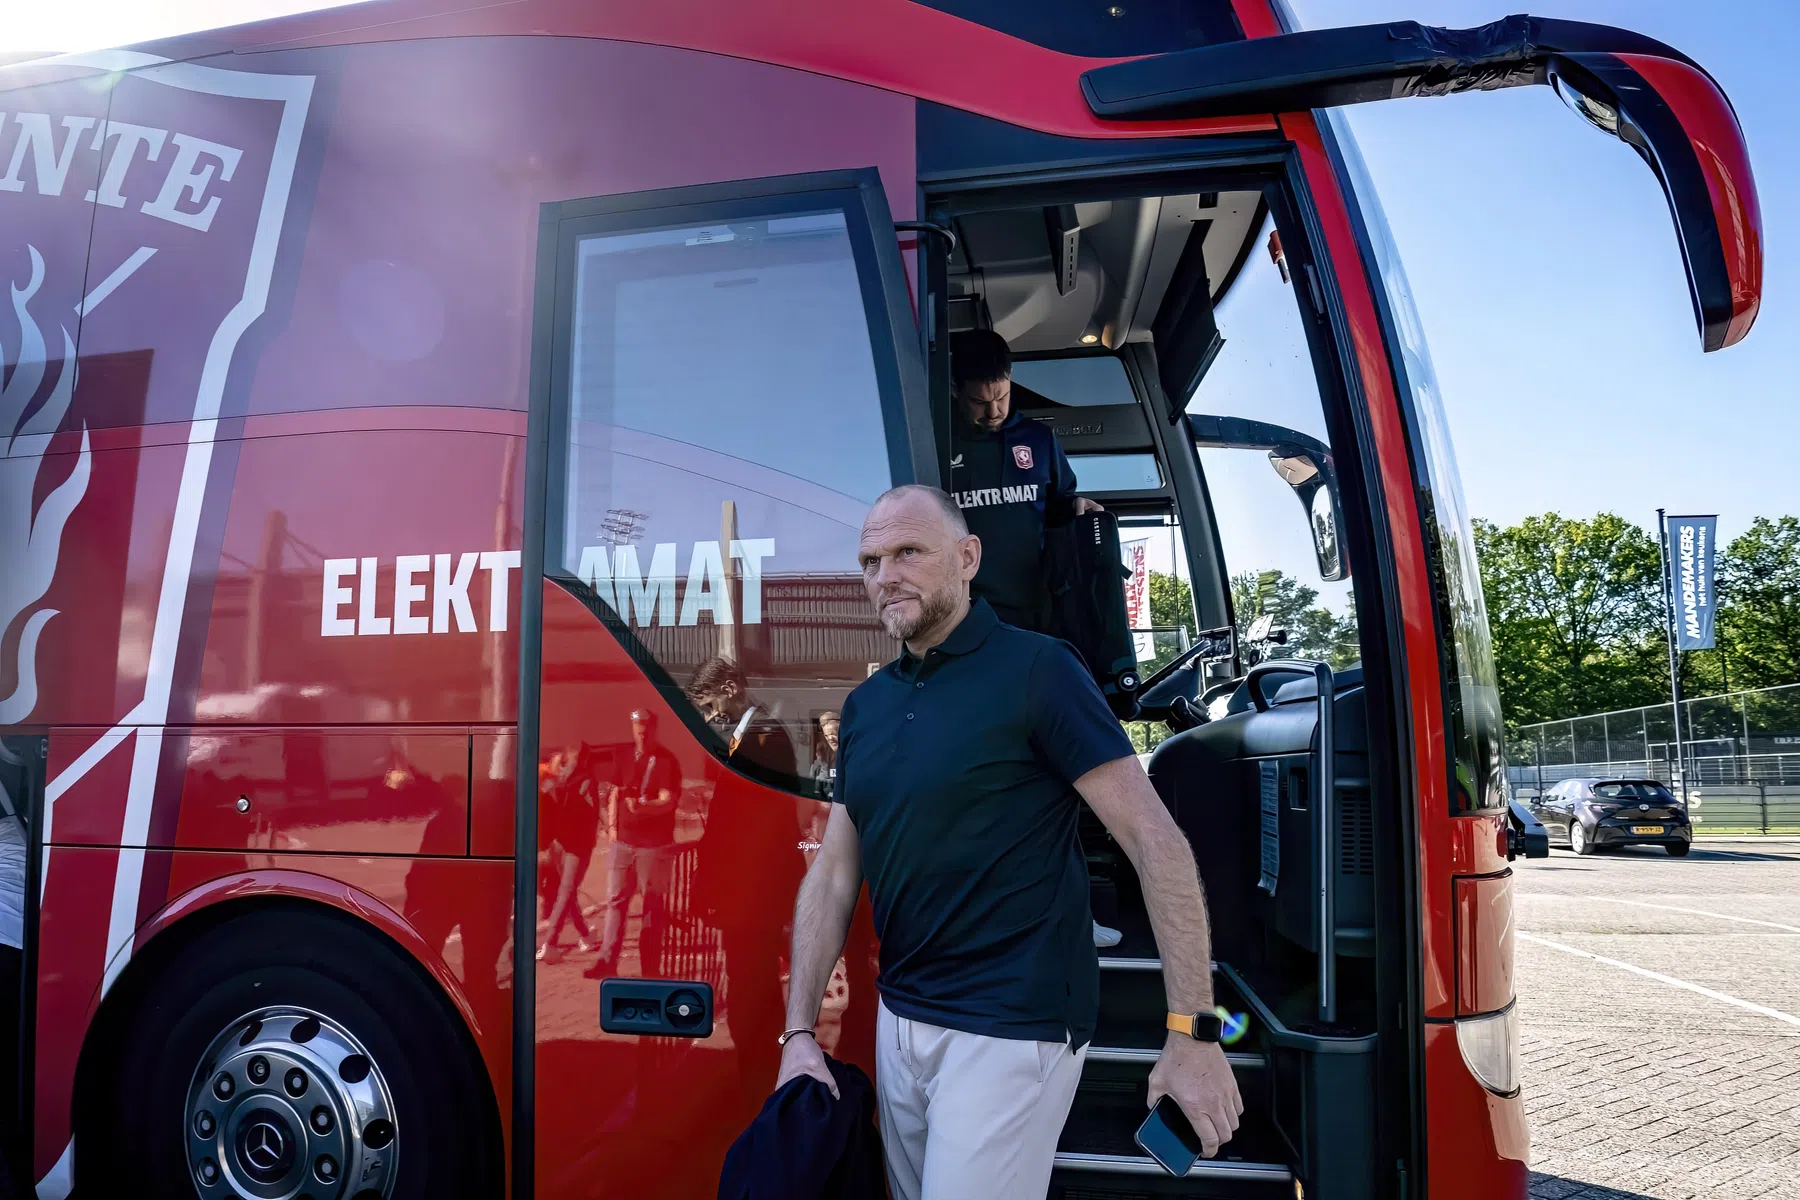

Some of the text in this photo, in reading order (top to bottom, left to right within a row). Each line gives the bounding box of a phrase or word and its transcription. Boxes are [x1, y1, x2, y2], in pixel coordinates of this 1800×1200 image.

[0, 112, 244, 233] NTE
[951, 484, 1039, 509] LEKTRAMAT
[1680, 525, 1700, 639] MANDEMAKERS
[1697, 559, 1705, 574] van
